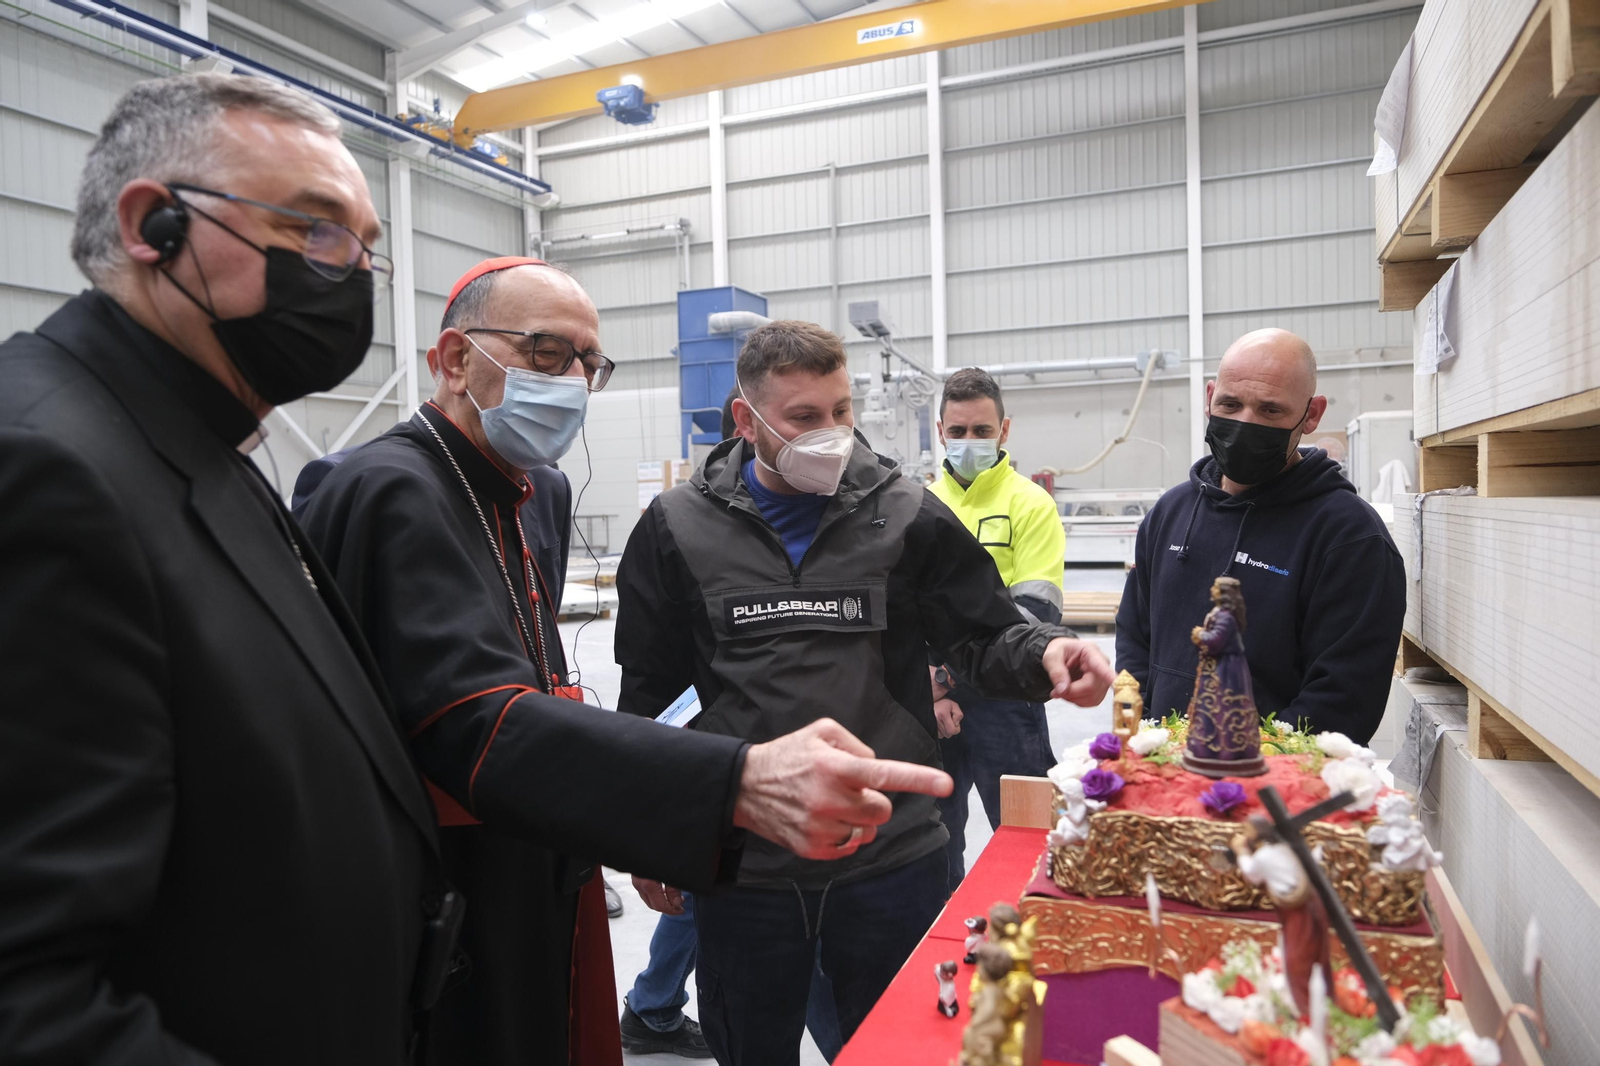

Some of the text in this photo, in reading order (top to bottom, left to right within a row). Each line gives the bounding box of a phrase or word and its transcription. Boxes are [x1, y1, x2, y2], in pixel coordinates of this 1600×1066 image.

[861, 26, 894, 40] ABUS
[733, 600, 838, 618] PULL&BEAR
[734, 615, 767, 624] INSPIRING
[767, 611, 793, 620] FUTURE
